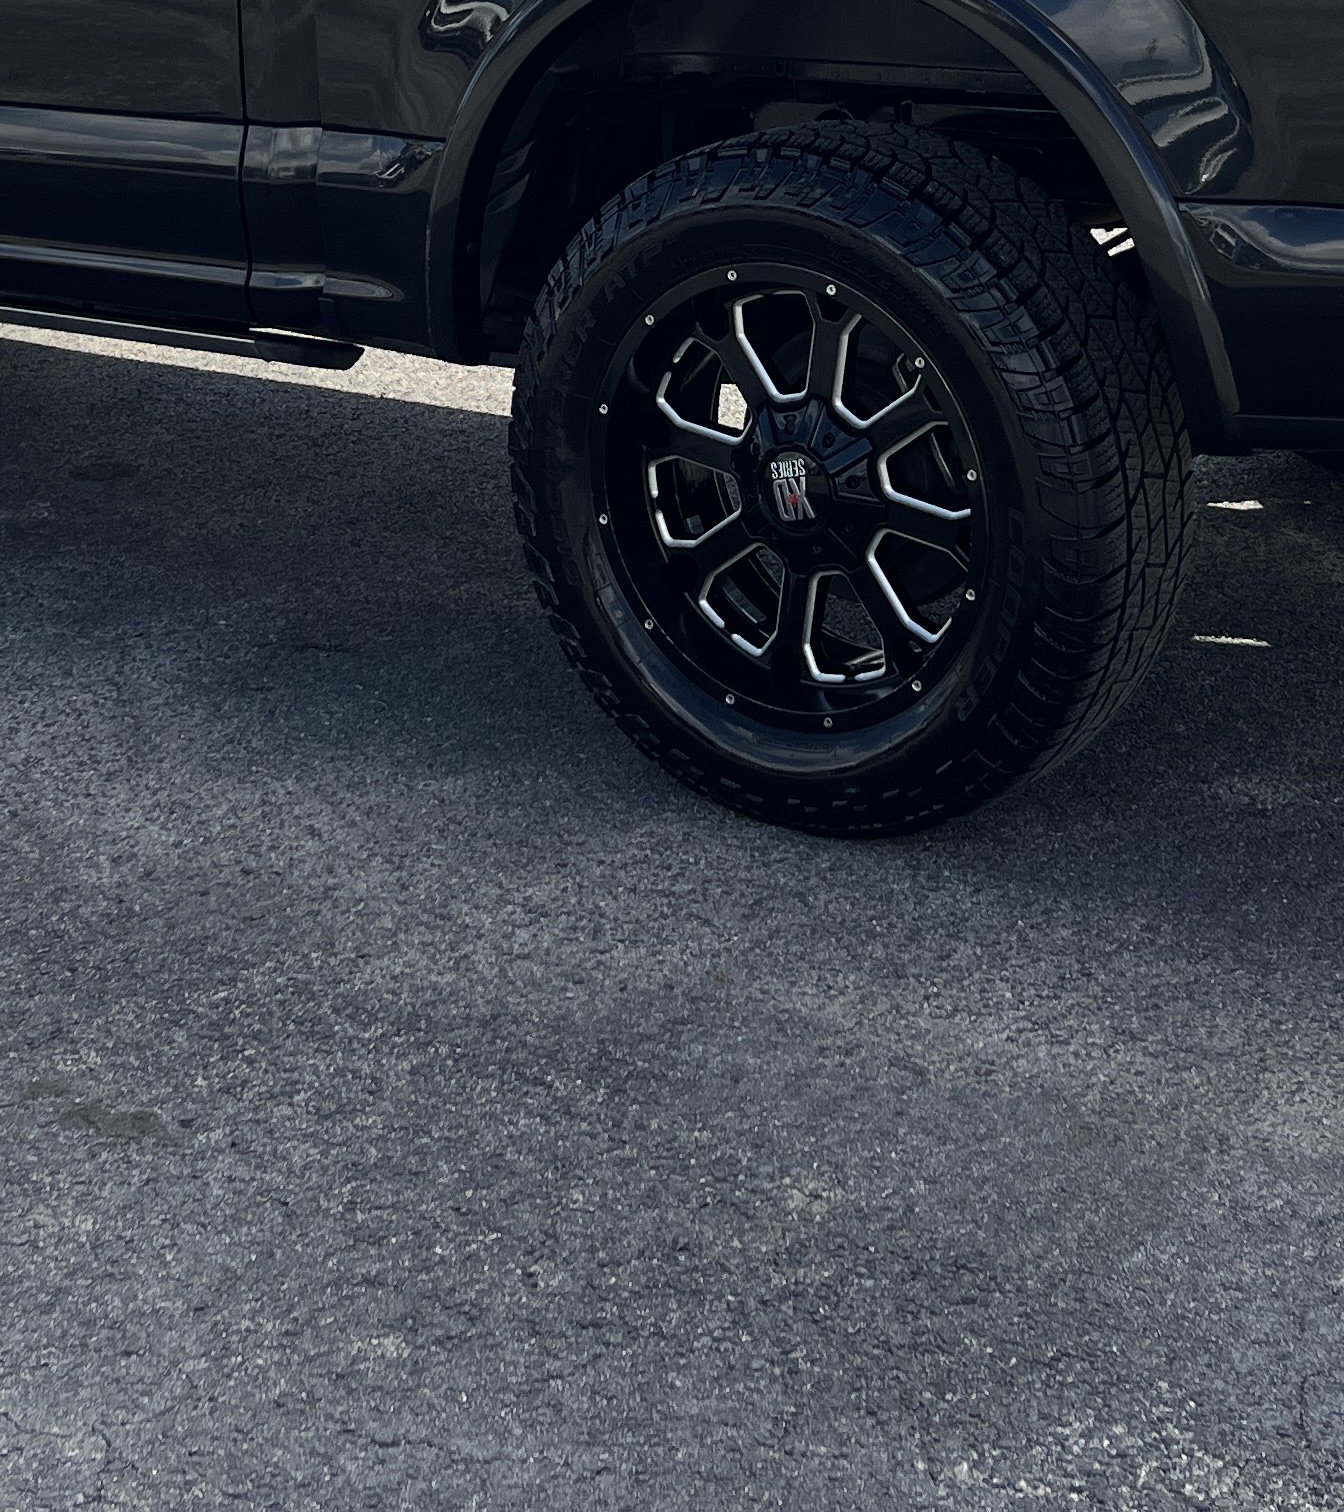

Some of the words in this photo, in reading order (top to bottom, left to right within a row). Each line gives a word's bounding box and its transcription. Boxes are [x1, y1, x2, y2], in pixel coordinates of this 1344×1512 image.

[770, 458, 806, 479] SERIES
[773, 476, 815, 522] XD
[954, 507, 1027, 723] COOPER
